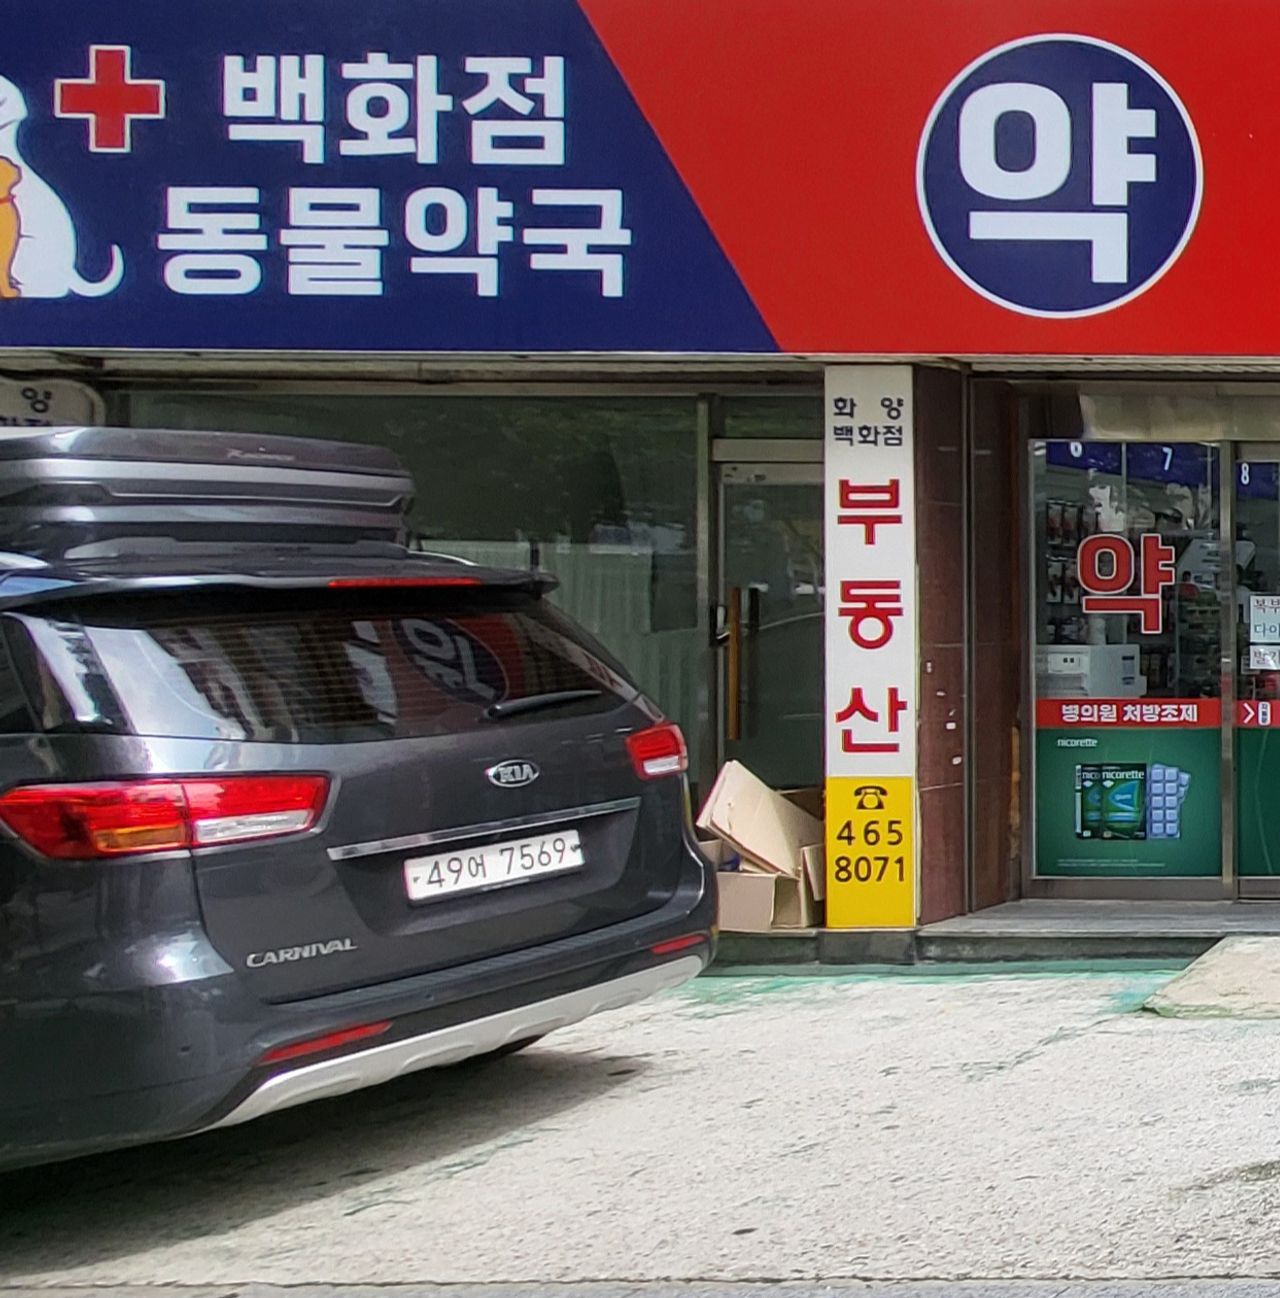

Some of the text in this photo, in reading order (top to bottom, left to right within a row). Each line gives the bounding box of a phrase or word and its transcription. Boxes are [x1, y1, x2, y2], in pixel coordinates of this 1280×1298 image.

[223, 53, 565, 165] 백화점
[959, 82, 1157, 283] 약
[158, 187, 632, 297] 동물약국
[833, 424, 904, 447] 백화점
[1162, 447, 1173, 471] 7
[1240, 462, 1250, 485] 8
[1077, 534, 1176, 635] 약
[835, 479, 908, 753] 부동산
[1062, 704, 1198, 723] 병의원 처방조제
[494, 763, 535, 783] KIA
[1102, 769, 1145, 780] nicorette
[837, 820, 904, 847] 465
[427, 835, 566, 888] 49어 7569
[834, 857, 906, 883] 8071
[247, 937, 359, 968] CARNIVAL
